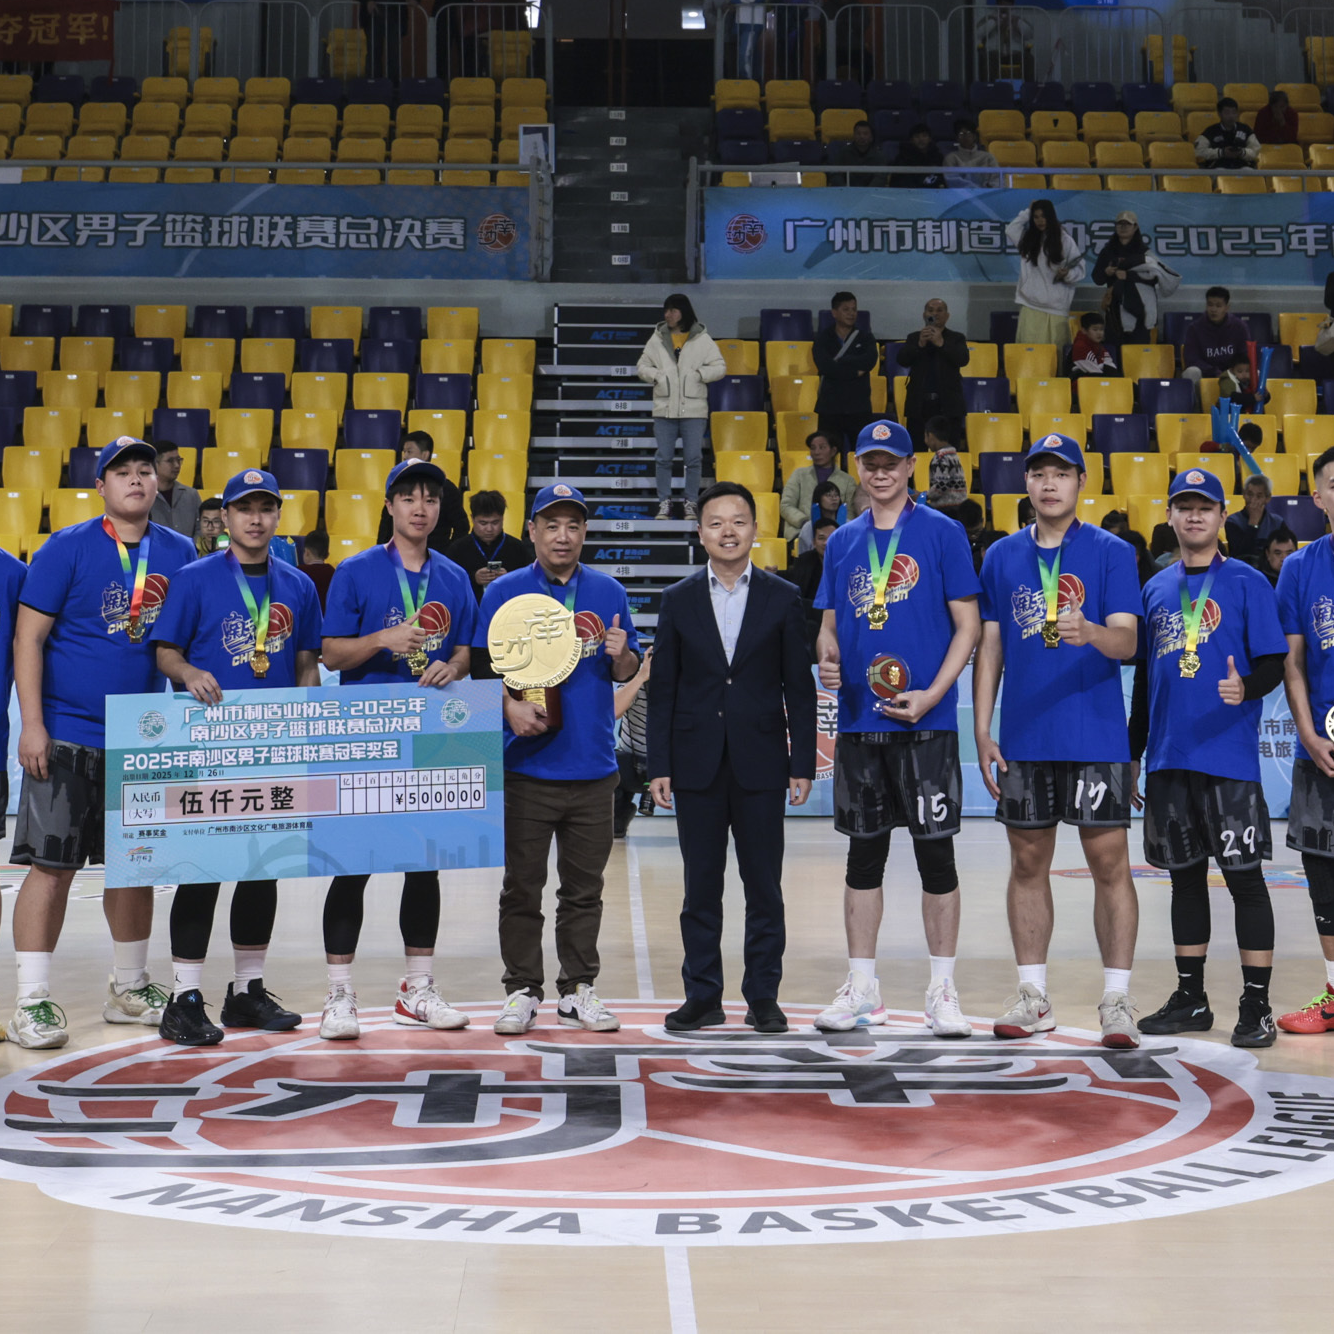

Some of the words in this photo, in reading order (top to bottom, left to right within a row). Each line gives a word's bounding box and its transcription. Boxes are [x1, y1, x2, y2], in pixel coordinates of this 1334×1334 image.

[591, 330, 616, 341] ACT
[595, 389, 621, 400] ACT
[595, 425, 622, 436] ACT
[594, 464, 621, 475] ACT
[594, 548, 624, 560] ACT
[568, 637, 582, 666] LEAGUE
[184, 697, 428, 724] 广州市制造业协会·2025年
[189, 716, 422, 743] 南沙区男子篮球联赛总决赛
[122, 741, 399, 771] 2025年南沙区男子篮球联赛冠军奖金
[151, 770, 172, 780] 2025
[183, 769, 194, 778] 12
[207, 768, 218, 777] 26
[130, 791, 161, 804] 人民币
[178, 785, 295, 816] 伍仟元整
[916, 792, 948, 826] 15
[1220, 824, 1256, 858] 29
[110, 1181, 583, 1235] NANSHA
[655, 1160, 1285, 1236] BASKETBALL
